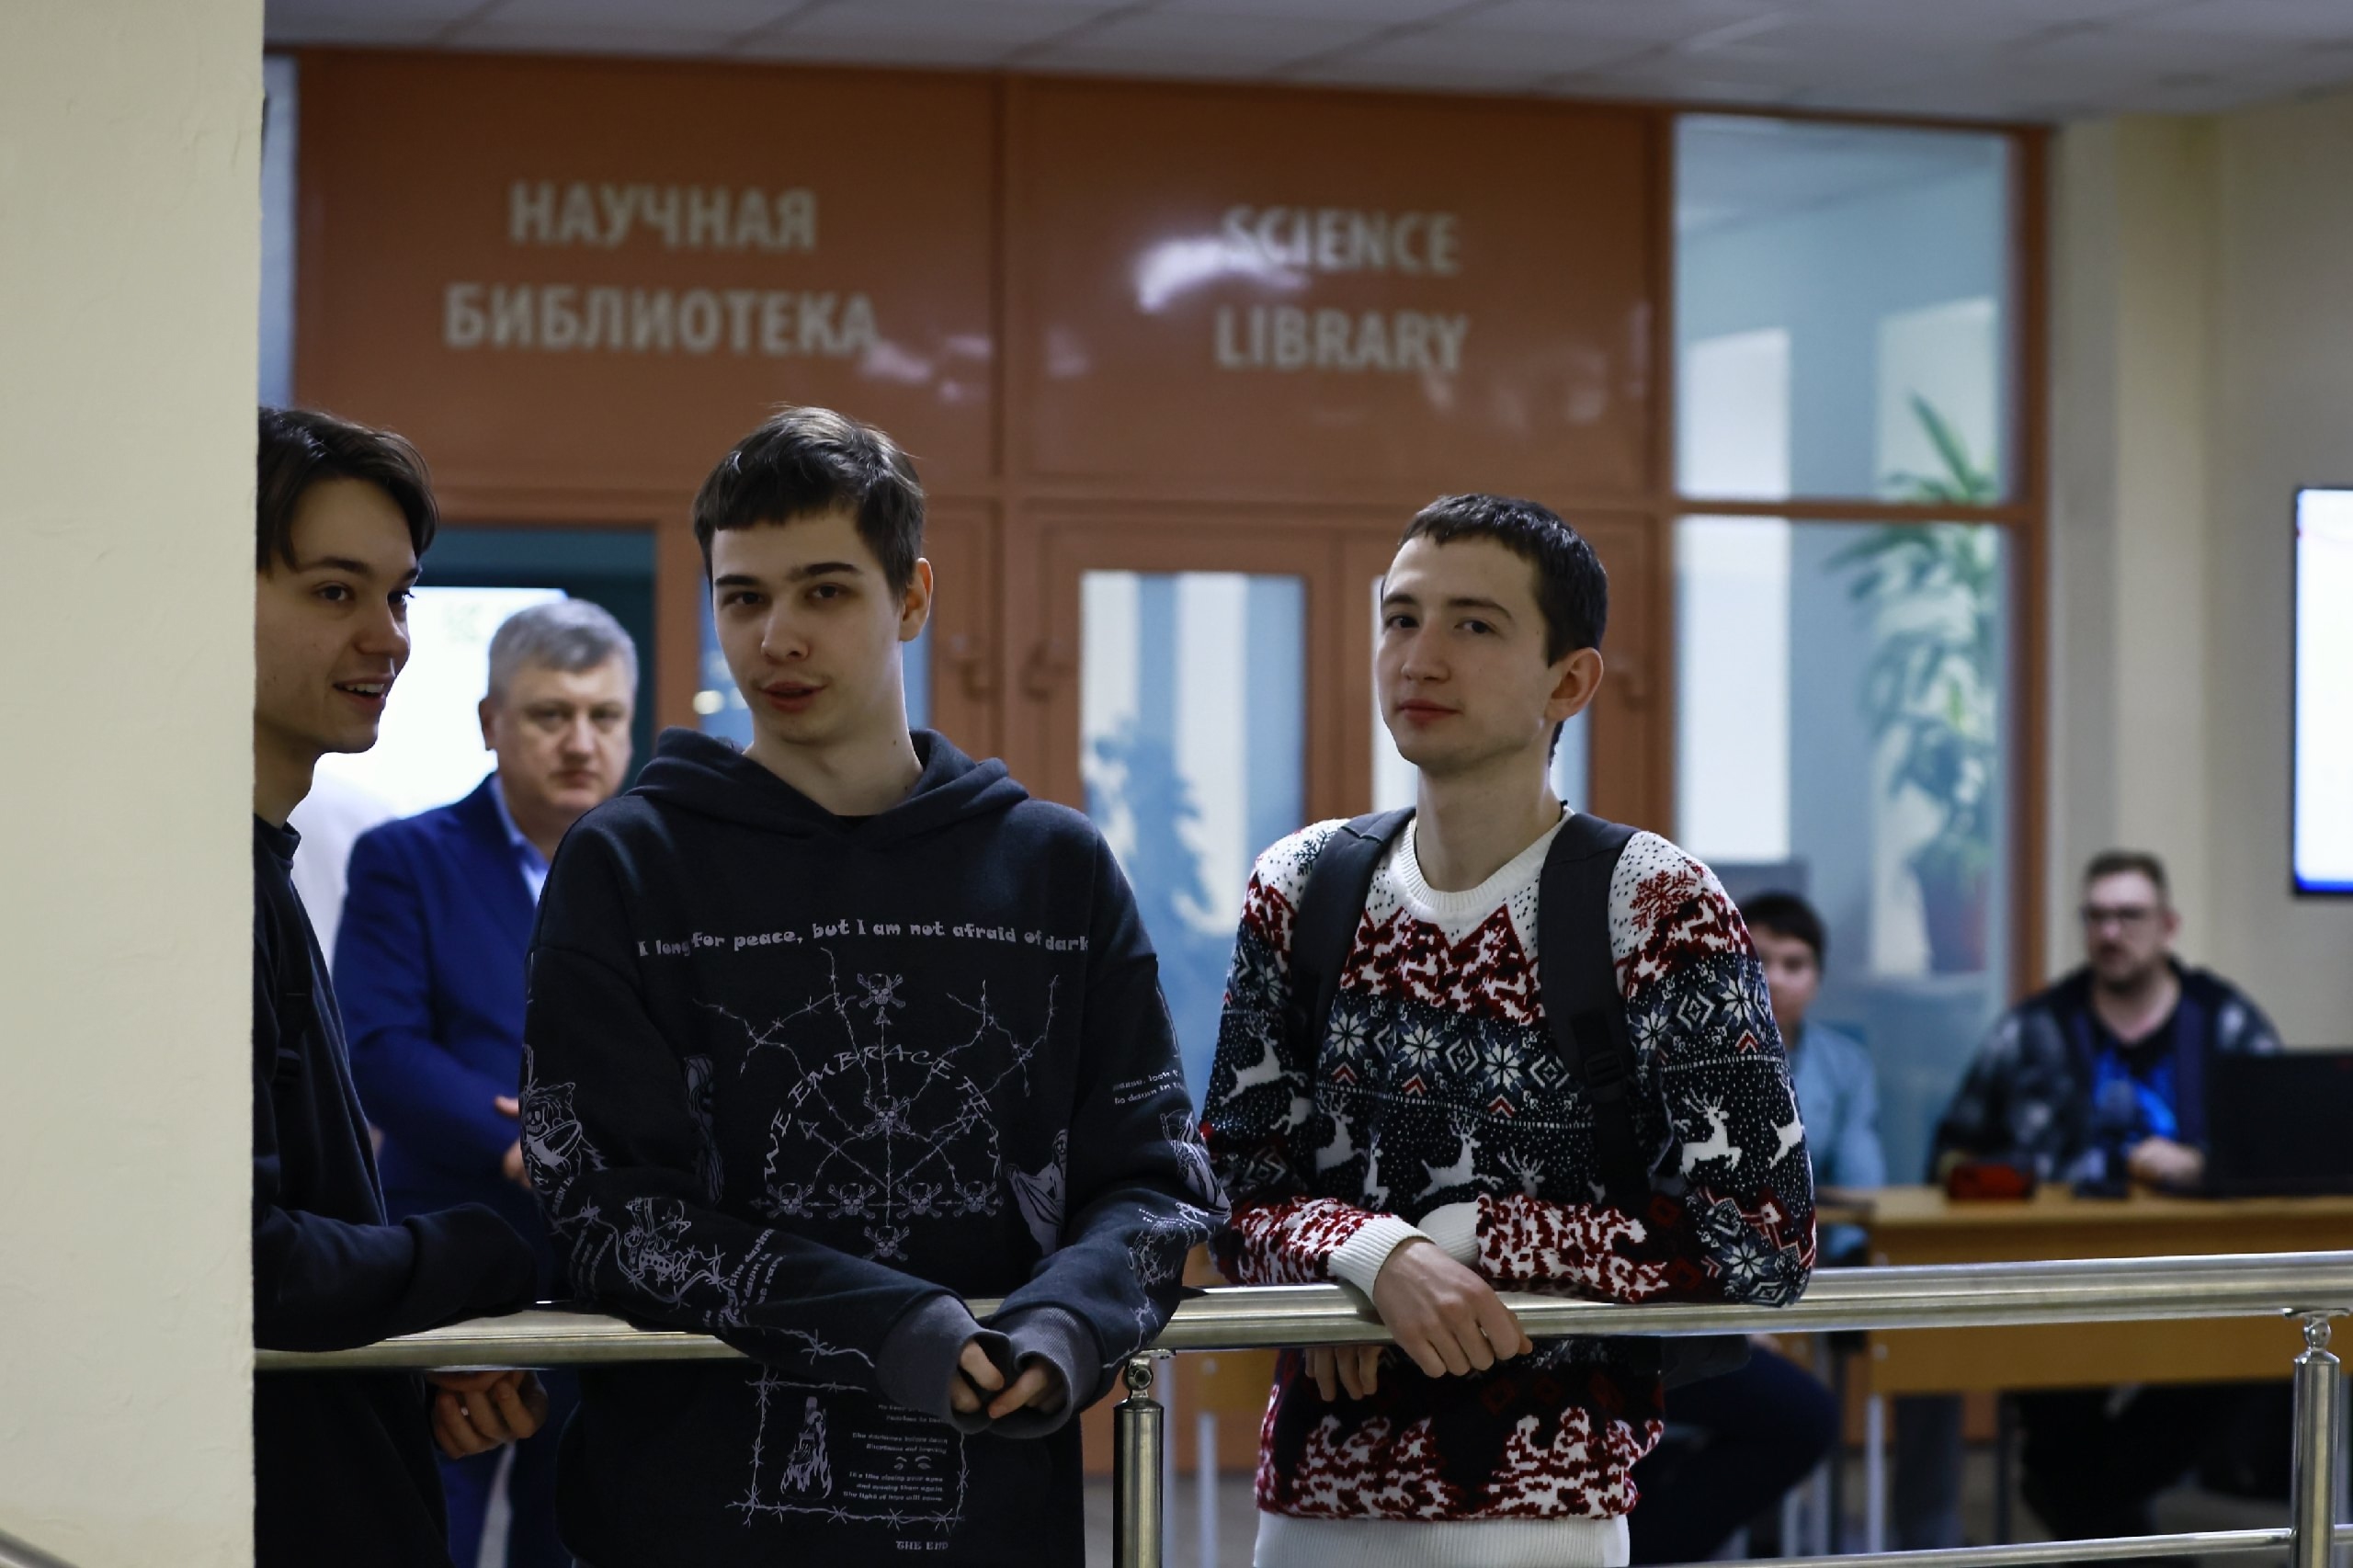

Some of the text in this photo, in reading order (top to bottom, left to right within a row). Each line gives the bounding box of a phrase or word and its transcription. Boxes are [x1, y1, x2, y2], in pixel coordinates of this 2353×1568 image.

[509, 182, 816, 249] НАУЧНАЯ
[1222, 204, 1460, 273] SCIENCE
[443, 283, 880, 357] БИБЛИОТЕКА
[1214, 306, 1468, 370] LIBRARY
[637, 940, 649, 957] I
[655, 939, 690, 957] long
[691, 931, 725, 948] for
[733, 929, 803, 952] peace,
[812, 919, 850, 938] but
[857, 919, 866, 936] I
[872, 922, 902, 936] am
[909, 921, 946, 937] not
[952, 923, 1017, 943] afraid
[1024, 929, 1042, 946] of
